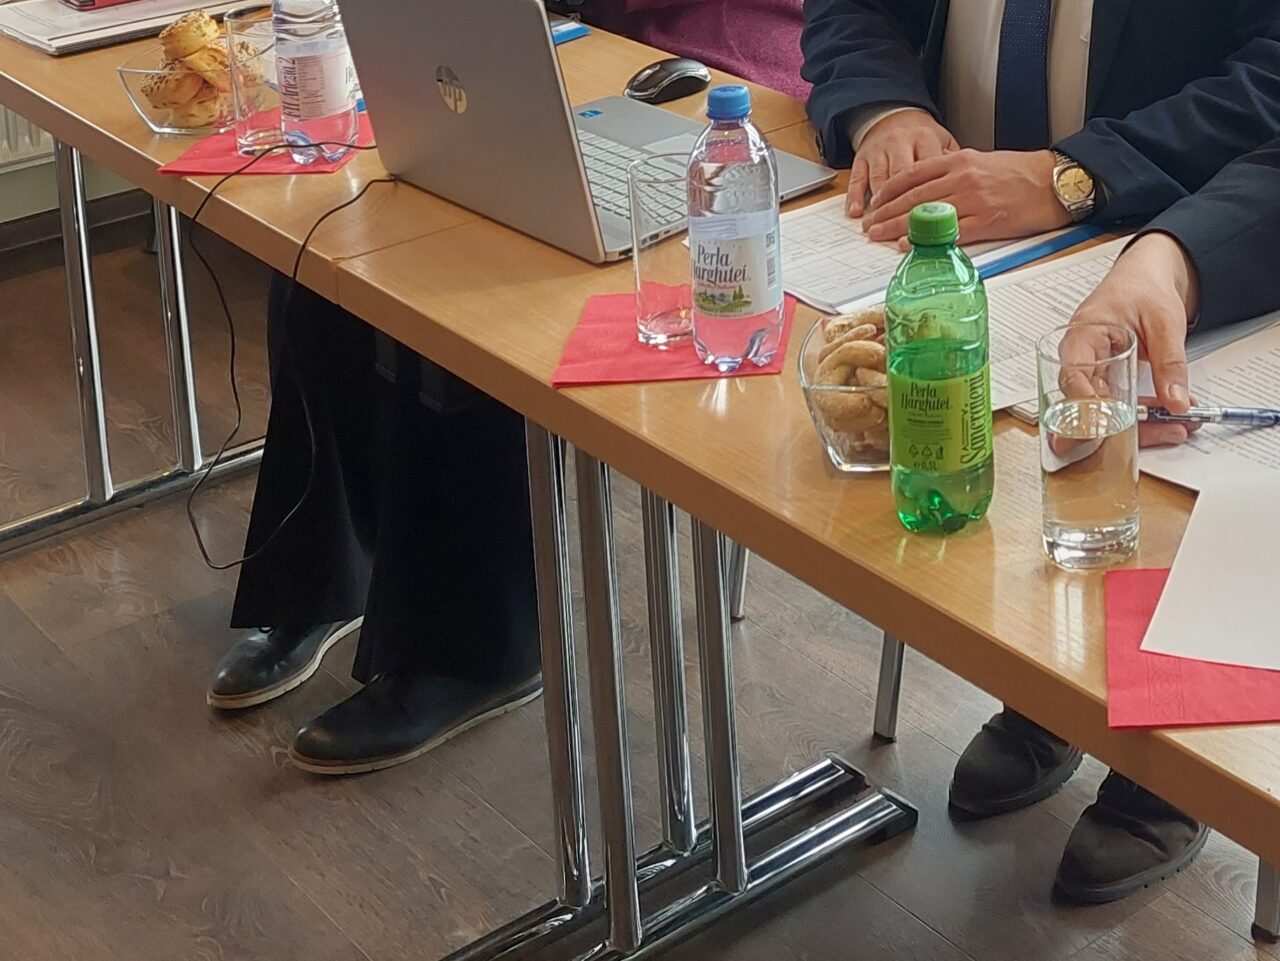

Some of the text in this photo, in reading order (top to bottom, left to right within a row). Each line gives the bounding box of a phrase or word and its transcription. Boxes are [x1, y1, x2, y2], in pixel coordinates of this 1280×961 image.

[697, 243, 732, 267] Perla
[910, 381, 937, 398] Perla
[900, 393, 950, 416] Harghitei
